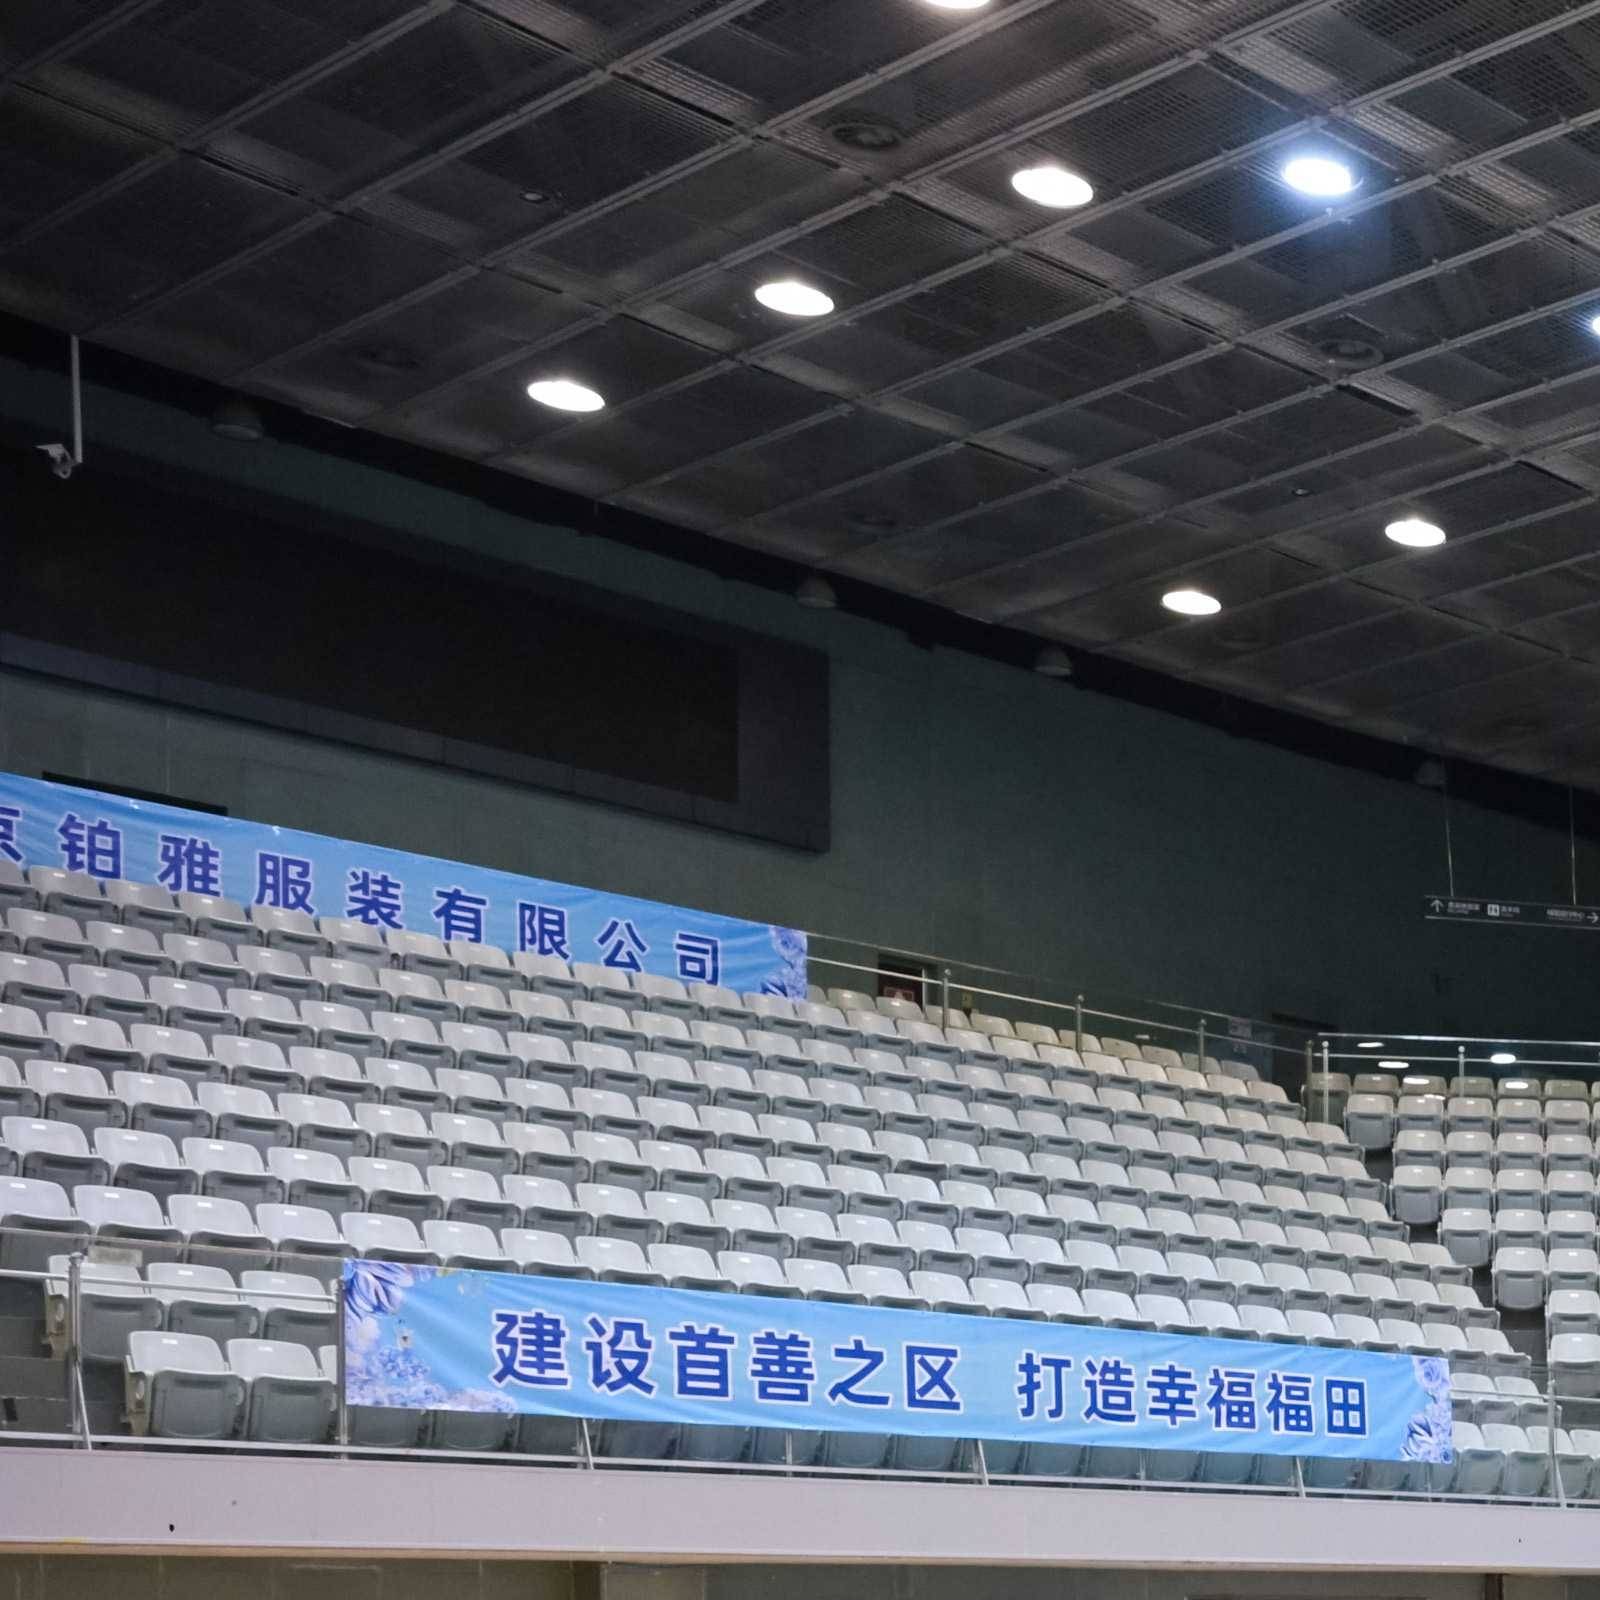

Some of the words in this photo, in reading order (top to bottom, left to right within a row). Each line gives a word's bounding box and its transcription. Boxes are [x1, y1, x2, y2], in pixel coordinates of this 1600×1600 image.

[490, 1307, 964, 1415] 建设首善之区
[1016, 1351, 1369, 1436] 打造幸福福田
